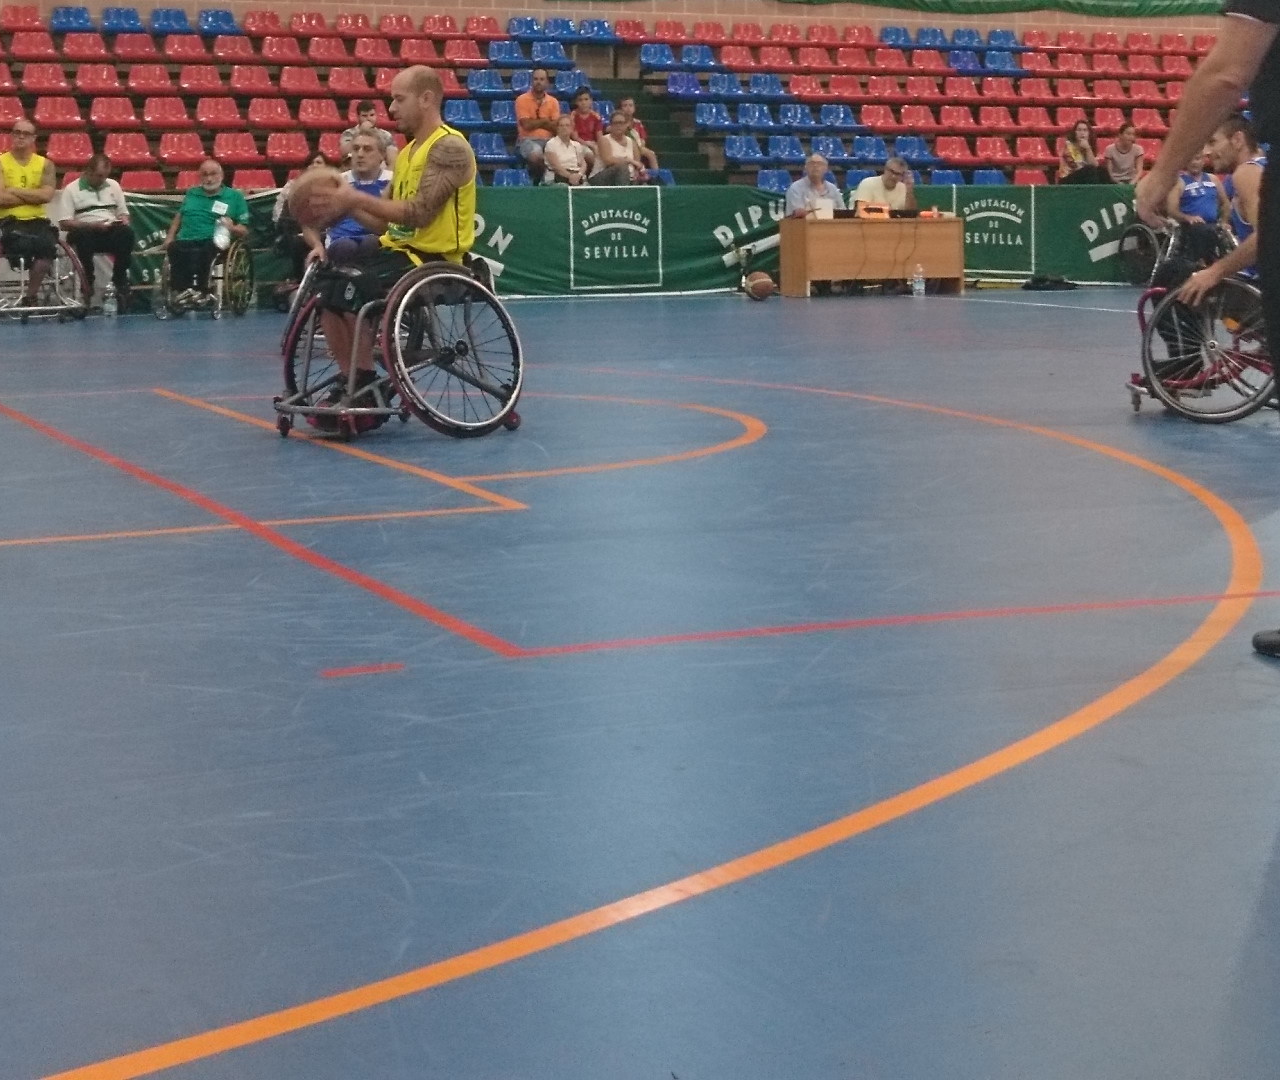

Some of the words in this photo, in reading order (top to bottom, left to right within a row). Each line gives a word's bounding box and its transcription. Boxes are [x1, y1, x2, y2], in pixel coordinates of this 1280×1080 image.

[963, 198, 1025, 216] DIPUTACION
[581, 209, 651, 229] DIPUTACION
[988, 220, 999, 229] DE
[611, 233, 622, 241] DE
[965, 233, 1023, 247] SEVILLA
[584, 245, 650, 260] SEVILLA
